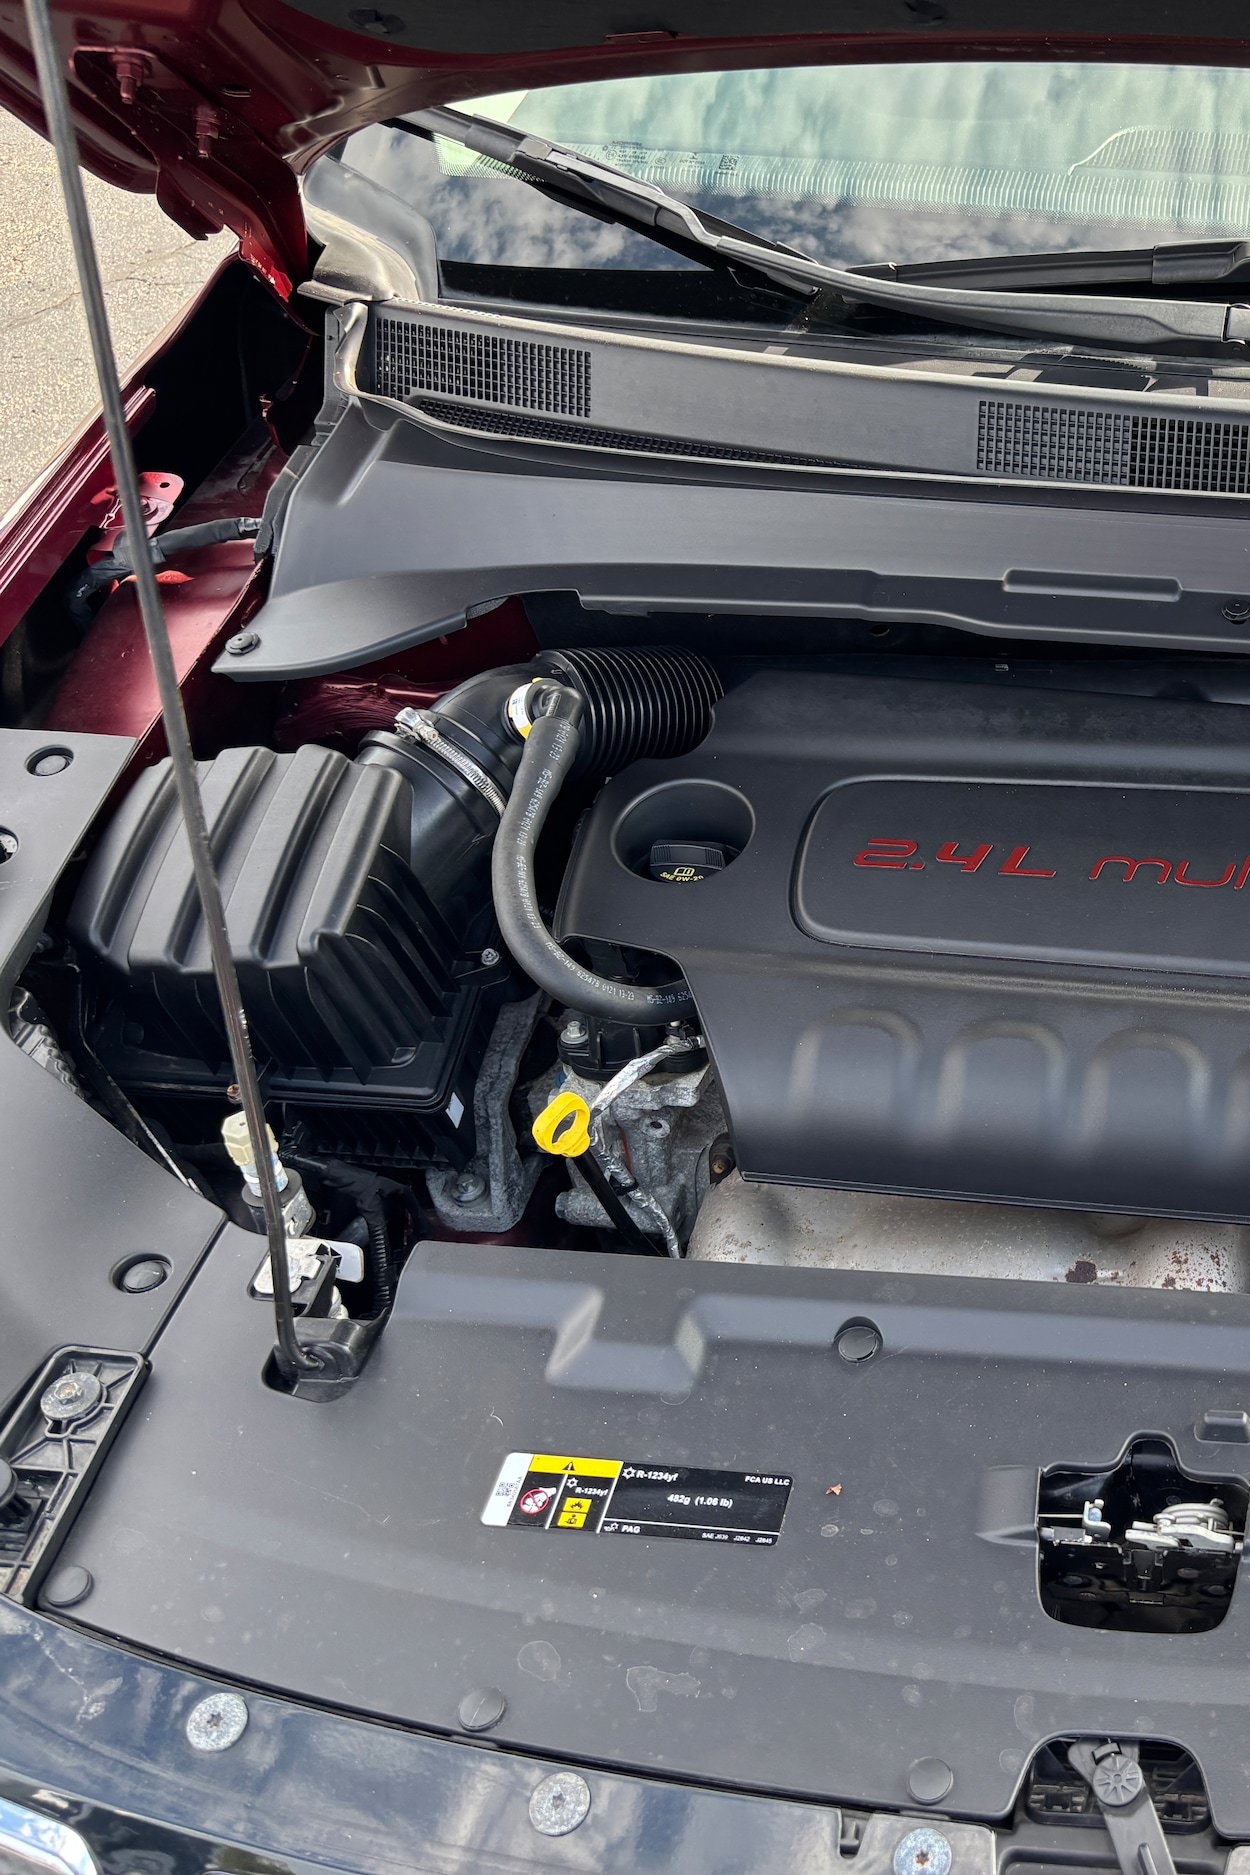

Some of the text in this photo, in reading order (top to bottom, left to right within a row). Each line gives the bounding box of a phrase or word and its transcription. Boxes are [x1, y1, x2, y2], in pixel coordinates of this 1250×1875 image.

[659, 871, 675, 881] SAE
[636, 1470, 679, 1482] R-1234yf
[744, 1475, 791, 1486] FCA US LLC
[575, 1485, 609, 1497] R-1234yf
[667, 1494, 734, 1509] 482g (1.06 lb)
[621, 1525, 641, 1534] PAG
